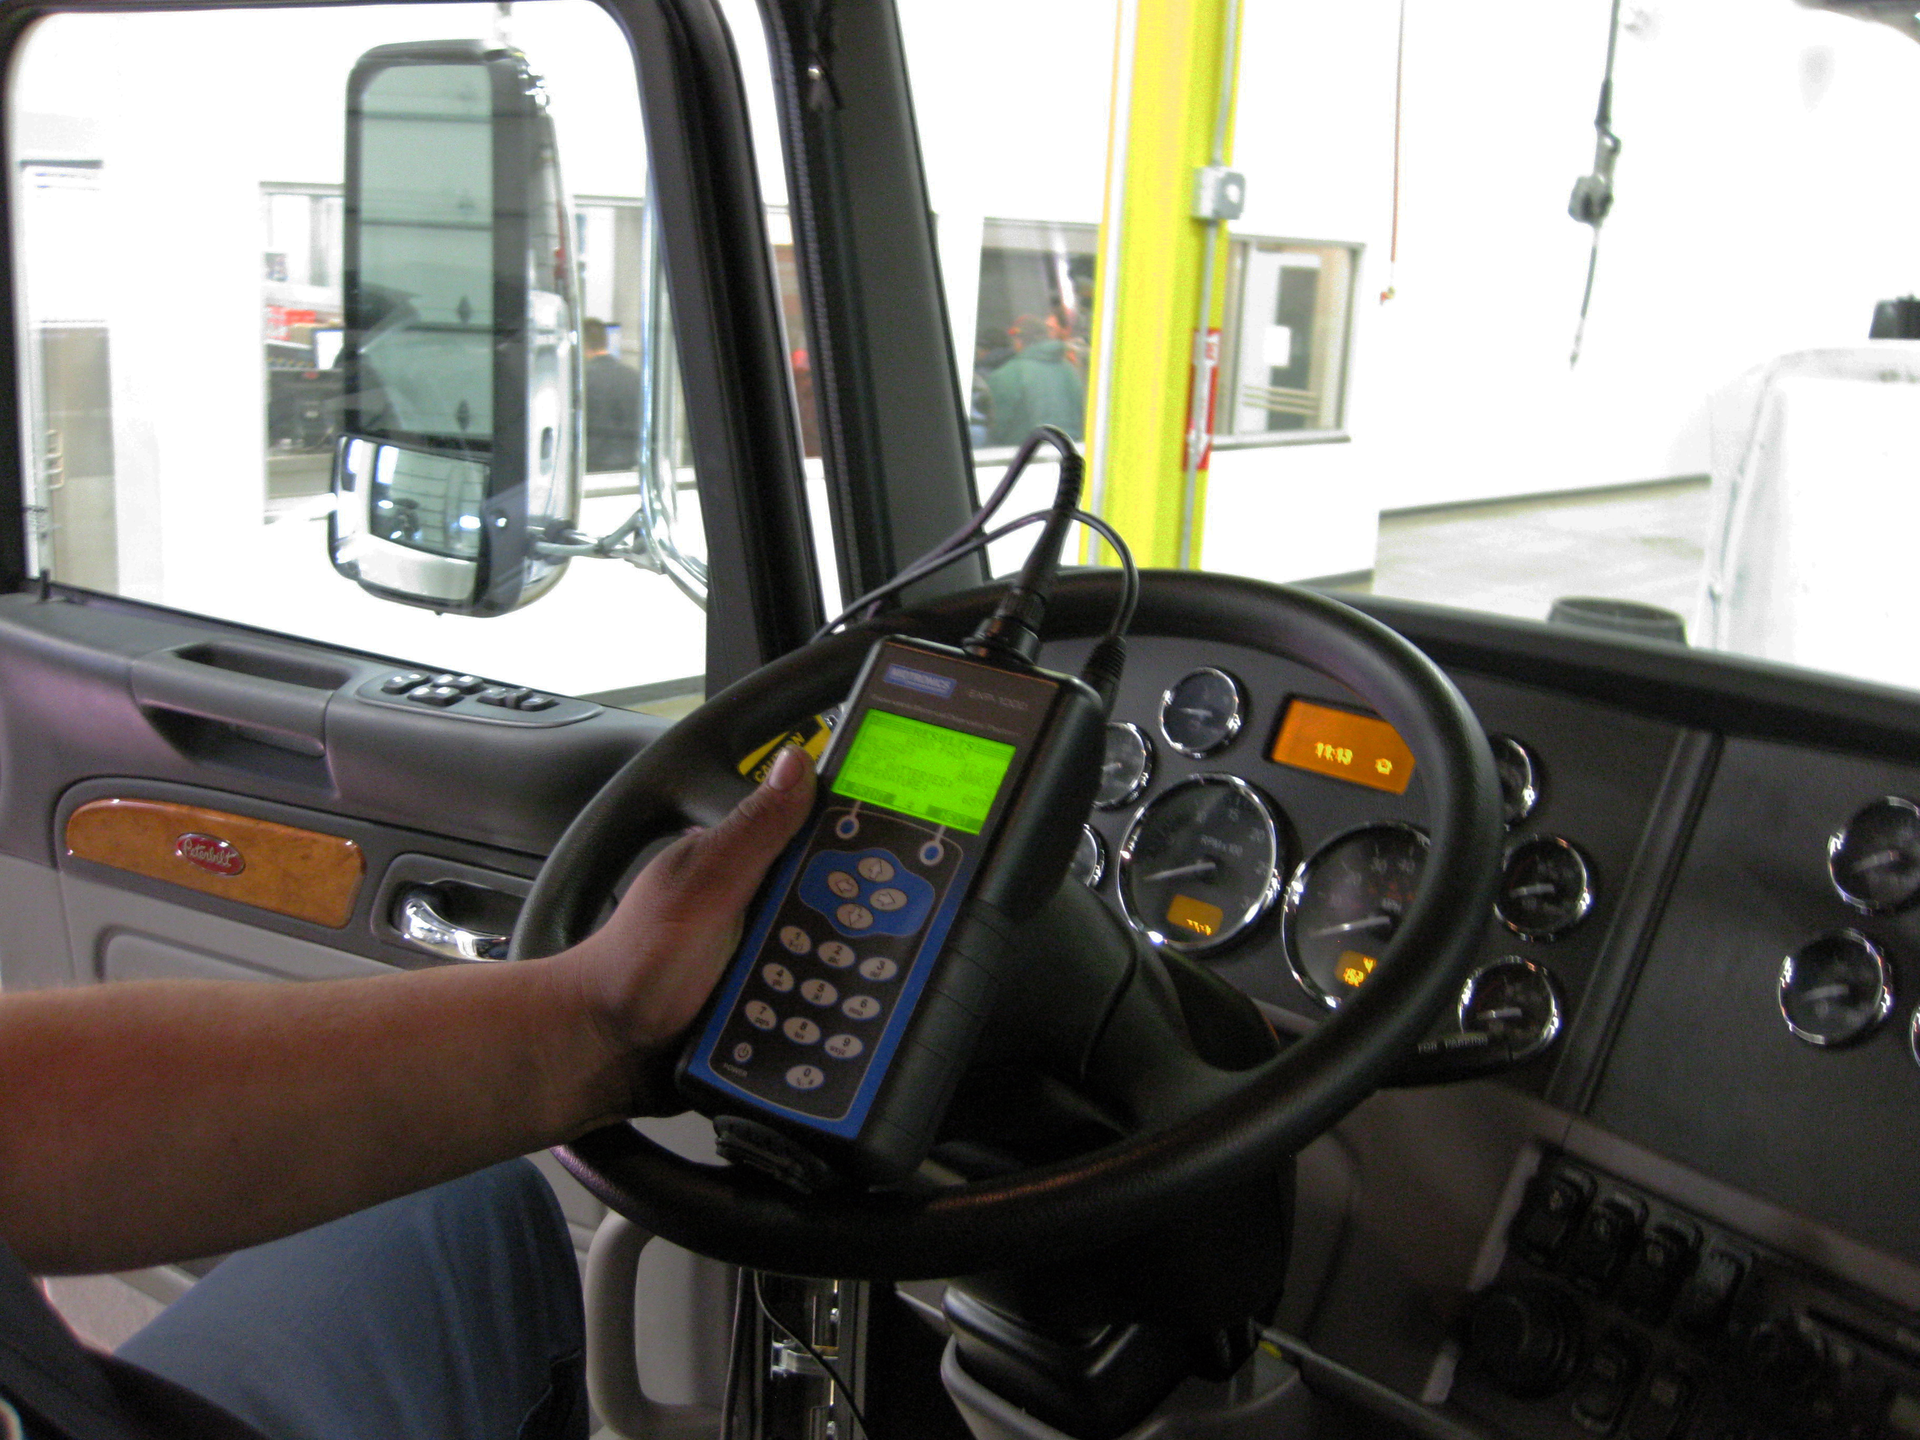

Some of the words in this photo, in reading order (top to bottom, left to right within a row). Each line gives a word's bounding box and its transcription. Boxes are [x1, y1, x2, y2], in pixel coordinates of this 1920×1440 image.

[183, 838, 237, 868] Peterbilt
[833, 945, 843, 956] 2
[876, 960, 886, 971] 3
[816, 983, 826, 993] 5
[860, 998, 868, 1009] 6
[799, 1021, 808, 1031] 8
[842, 1037, 851, 1047] 9
